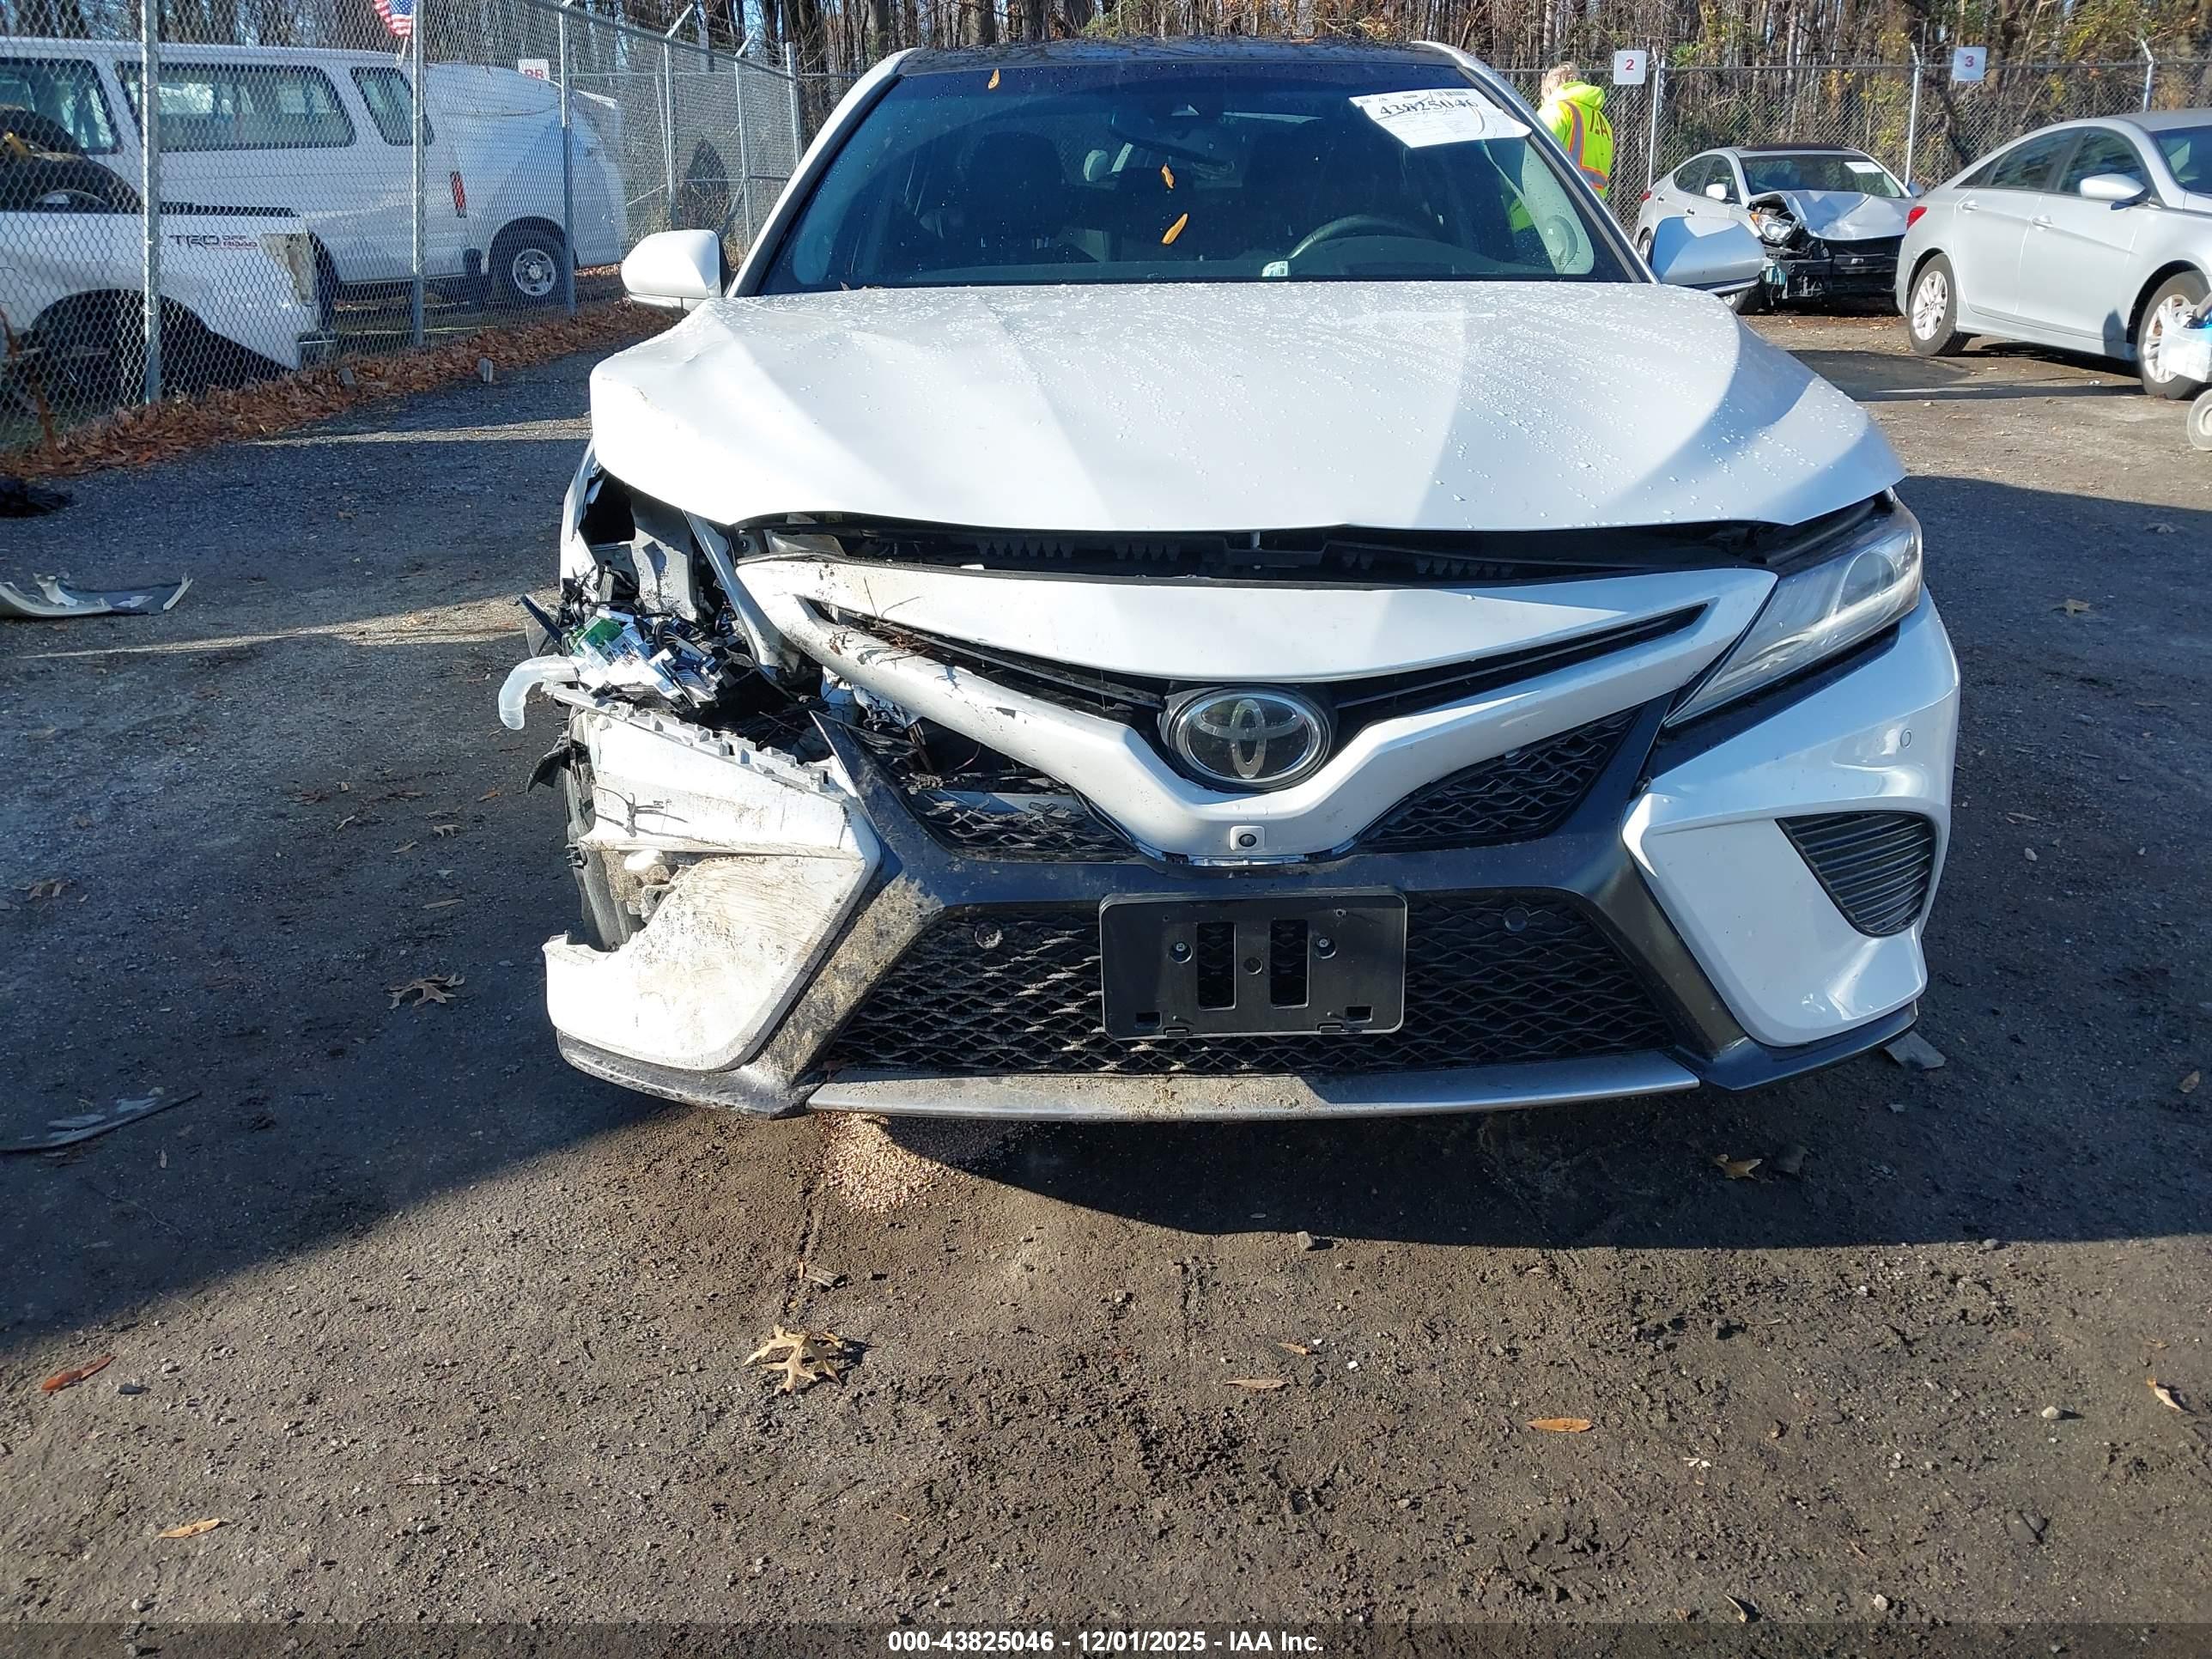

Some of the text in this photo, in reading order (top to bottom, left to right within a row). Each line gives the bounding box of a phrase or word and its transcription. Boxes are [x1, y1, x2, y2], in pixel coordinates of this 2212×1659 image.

[1626, 58, 1634, 70] 2
[1965, 55, 1974, 67] 3
[169, 234, 220, 248] TRD
